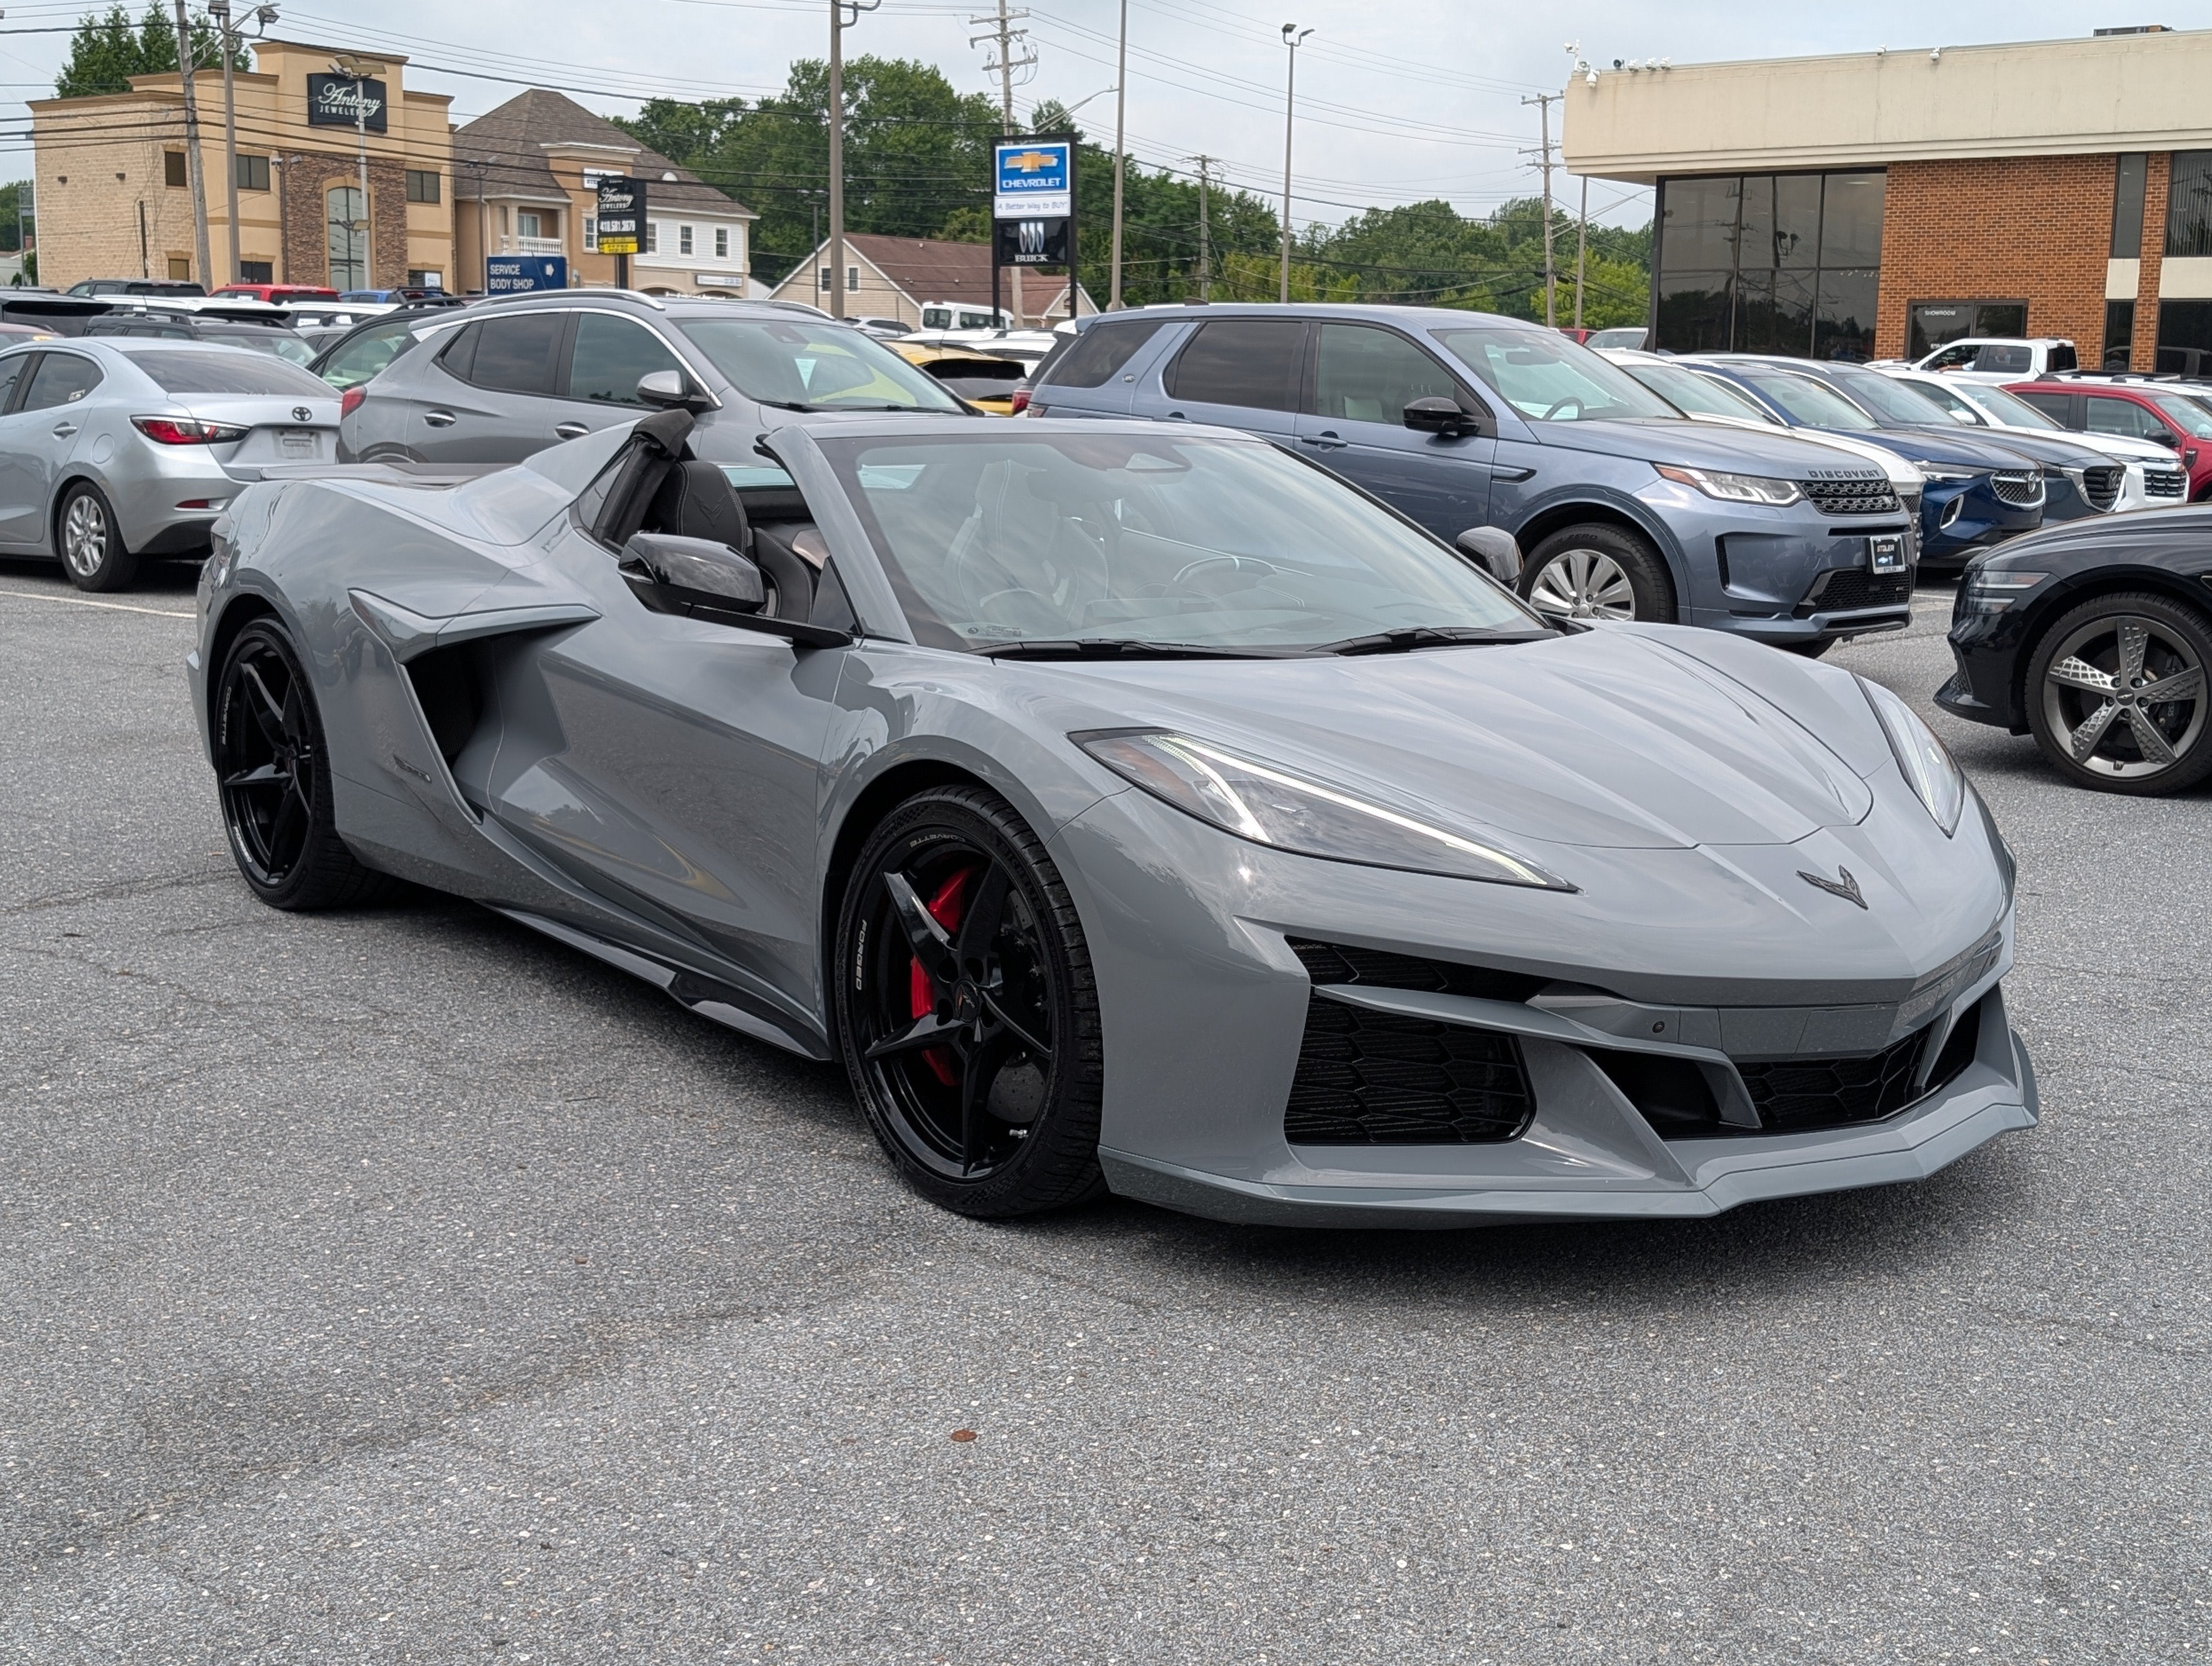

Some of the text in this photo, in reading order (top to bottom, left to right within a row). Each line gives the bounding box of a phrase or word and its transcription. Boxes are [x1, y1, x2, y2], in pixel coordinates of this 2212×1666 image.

[318, 83, 382, 116] Antony
[1003, 178, 1061, 188] CHEVROLET
[599, 187, 634, 208] Antony
[1027, 203, 1040, 212] Way
[490, 264, 520, 275] SERVICE
[490, 278, 535, 290] BODY SHOP
[1807, 470, 1880, 478] DISCOVERY
[910, 834, 965, 847] CORVETTE
[856, 919, 867, 990] FORGED
